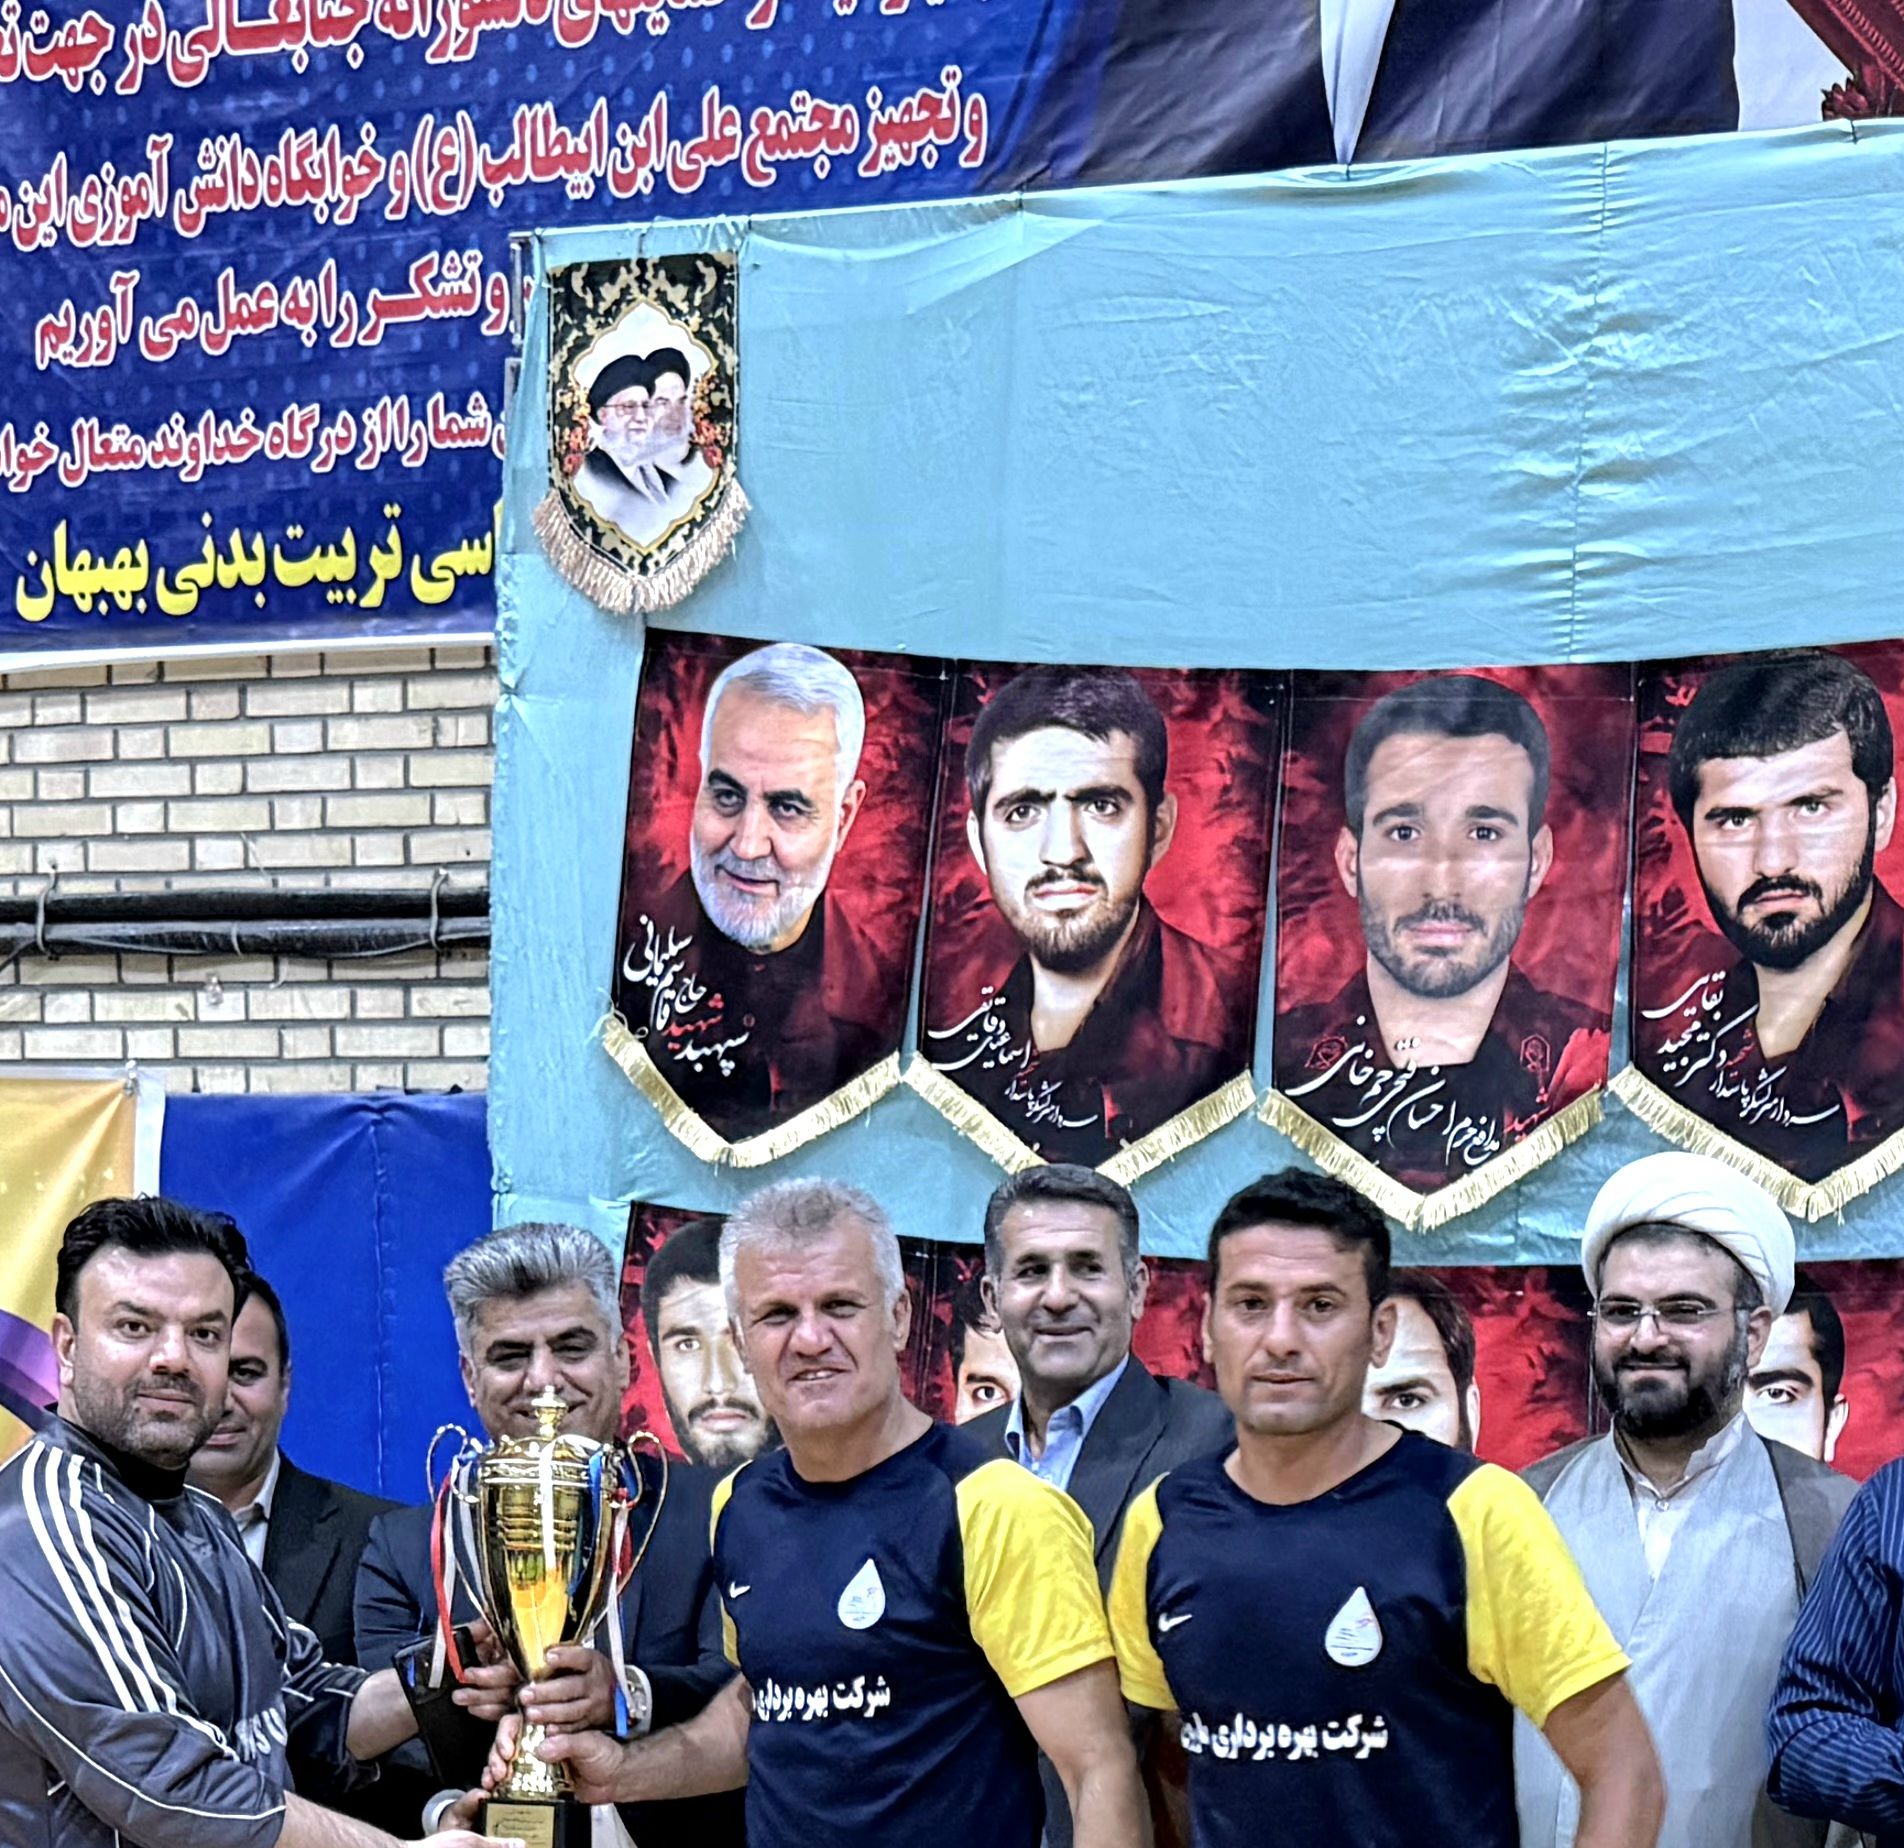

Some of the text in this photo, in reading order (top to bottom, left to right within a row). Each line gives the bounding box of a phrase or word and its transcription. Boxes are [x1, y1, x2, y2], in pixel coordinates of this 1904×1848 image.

[22, 10, 115, 96] جهت
[115, 0, 166, 95] در
[607, 90, 668, 199] ابن
[667, 86, 742, 194] علی
[741, 90, 859, 187] مجتمع
[859, 64, 962, 178] تجهیز
[960, 94, 988, 168] و
[12, 152, 67, 252] این
[263, 122, 387, 226] خوابگاه
[385, 150, 410, 220] و
[35, 270, 140, 370] آوریم
[139, 297, 200, 361] می
[200, 267, 280, 355] عمل
[280, 275, 318, 348] به
[318, 258, 358, 348] را
[358, 249, 484, 346] تشکر
[481, 272, 509, 336] و
[59, 411, 147, 487] متعال
[147, 407, 264, 483] خداوند
[355, 395, 391, 470] از
[392, 394, 428, 468] را
[427, 390, 493, 449] شما
[16, 519, 149, 622] بهبهان
[156, 511, 266, 616] بدنی
[273, 503, 402, 608] تربیت
[832, 1675, 891, 1718] شرکت
[1322, 1713, 1389, 1759] شرکت
